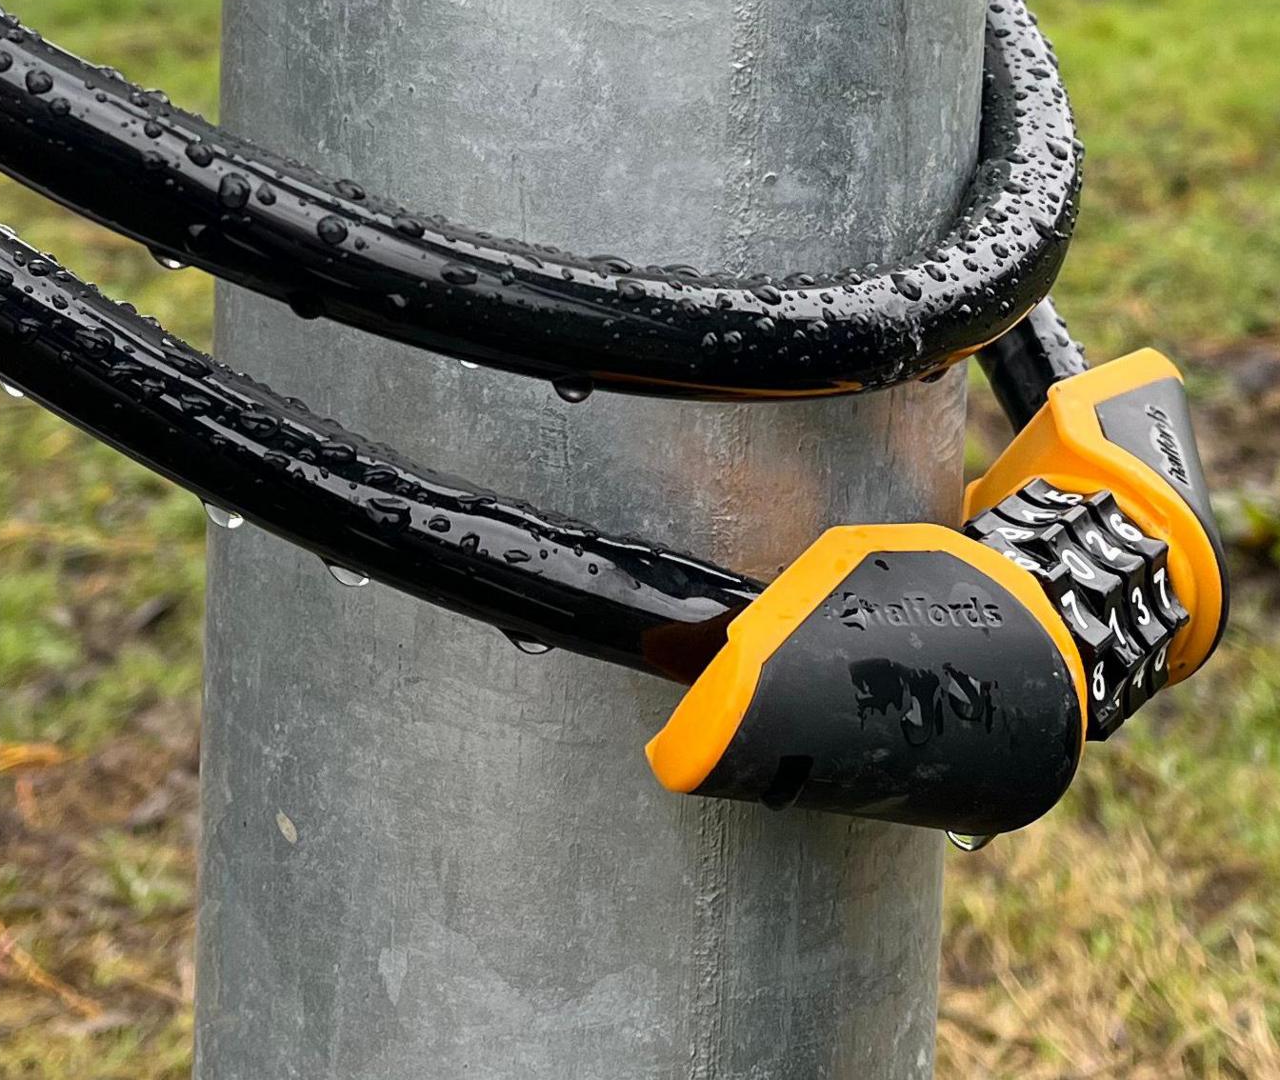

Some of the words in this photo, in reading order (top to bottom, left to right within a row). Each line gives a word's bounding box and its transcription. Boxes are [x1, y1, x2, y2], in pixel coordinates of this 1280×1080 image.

[1044, 491, 1084, 505] 5
[1110, 513, 1144, 542] 6
[1085, 531, 1121, 561] 2
[1061, 549, 1096, 580] 0
[1061, 590, 1089, 630] 7
[1093, 661, 1105, 700] 8
[1132, 587, 1150, 625] 3
[1153, 568, 1171, 609] 7
